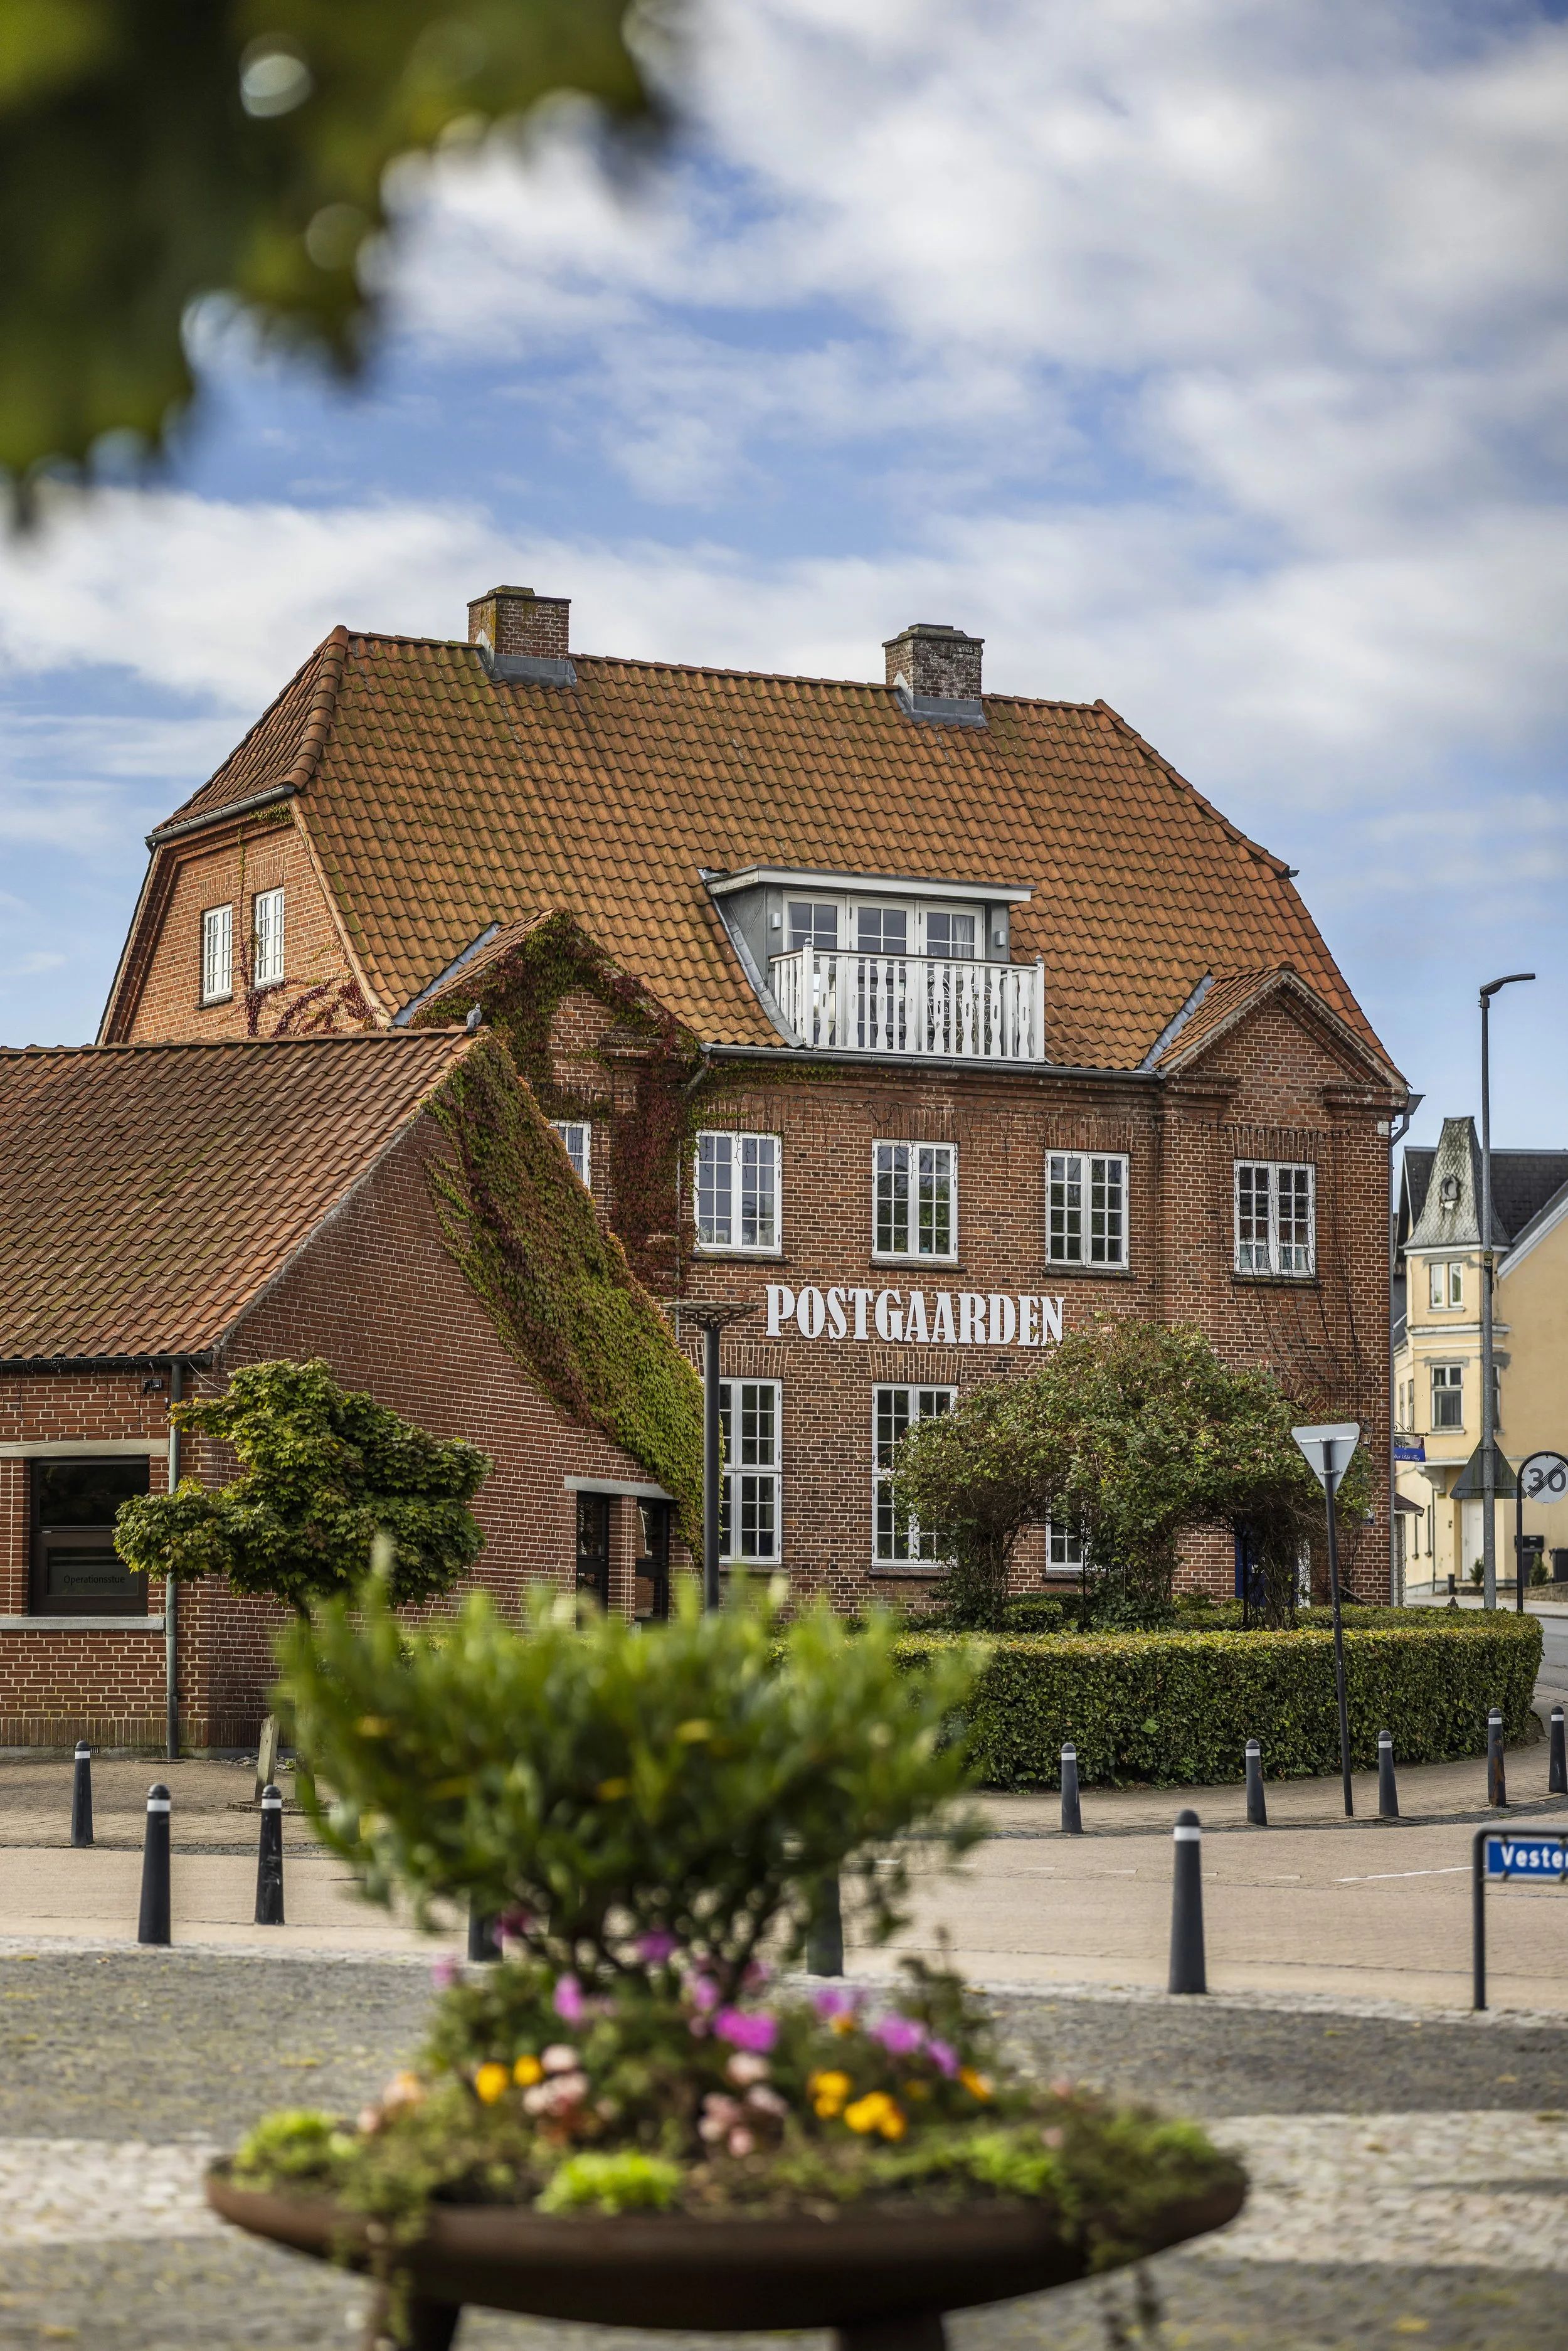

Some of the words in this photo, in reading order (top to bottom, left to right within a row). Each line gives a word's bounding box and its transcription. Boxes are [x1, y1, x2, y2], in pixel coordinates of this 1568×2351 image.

[765, 1285, 1064, 1346] POSTGAARDEN
[1527, 1468, 1566, 1492] 30
[63, 1574, 125, 1586] Operationsstue
